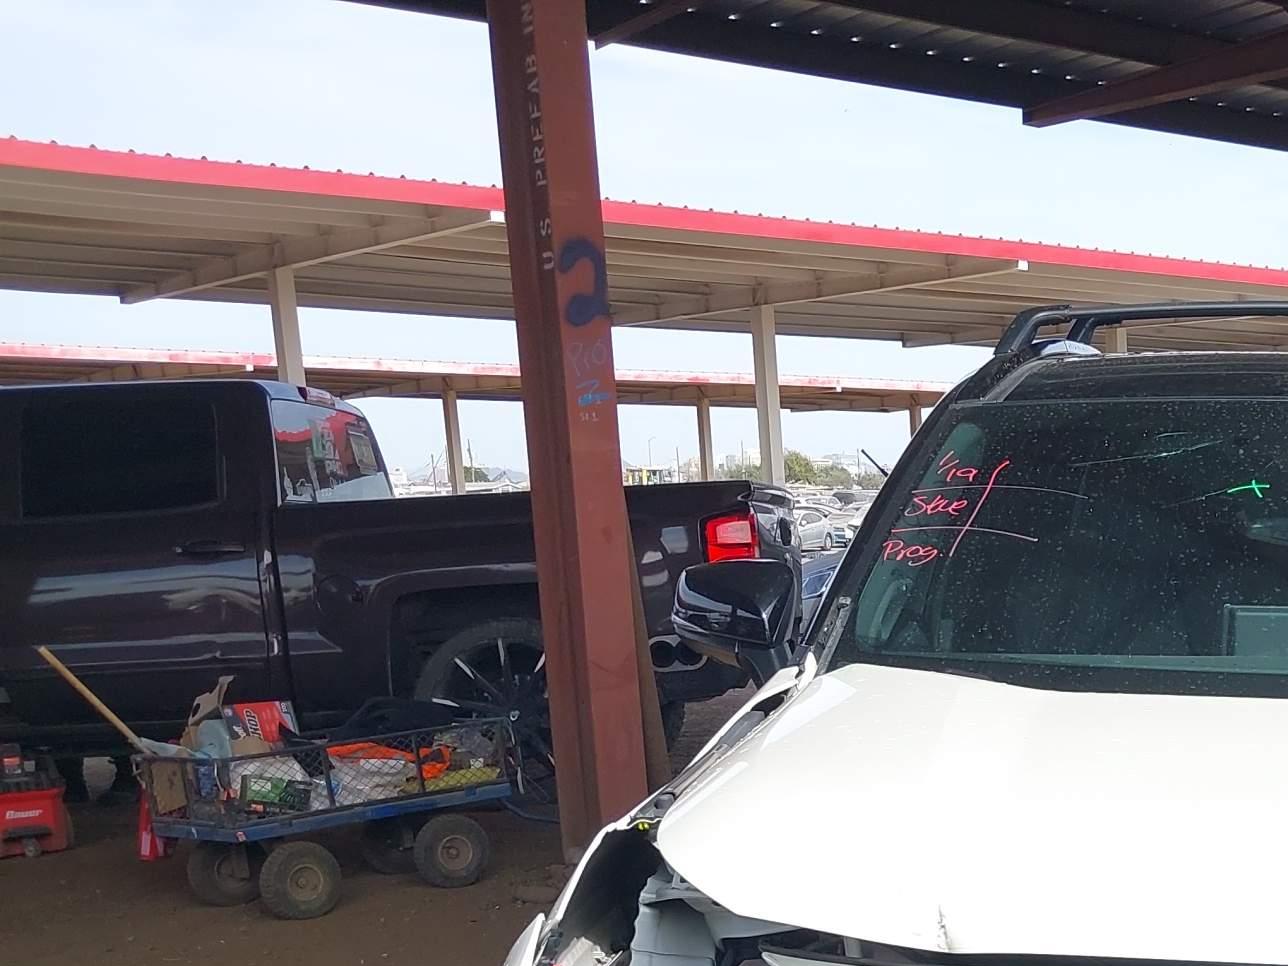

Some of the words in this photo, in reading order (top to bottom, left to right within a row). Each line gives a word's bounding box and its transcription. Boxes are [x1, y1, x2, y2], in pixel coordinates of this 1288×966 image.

[525, 54, 547, 187] PREFAB
[557, 234, 608, 327] 2
[243, 707, 264, 739] HOP
